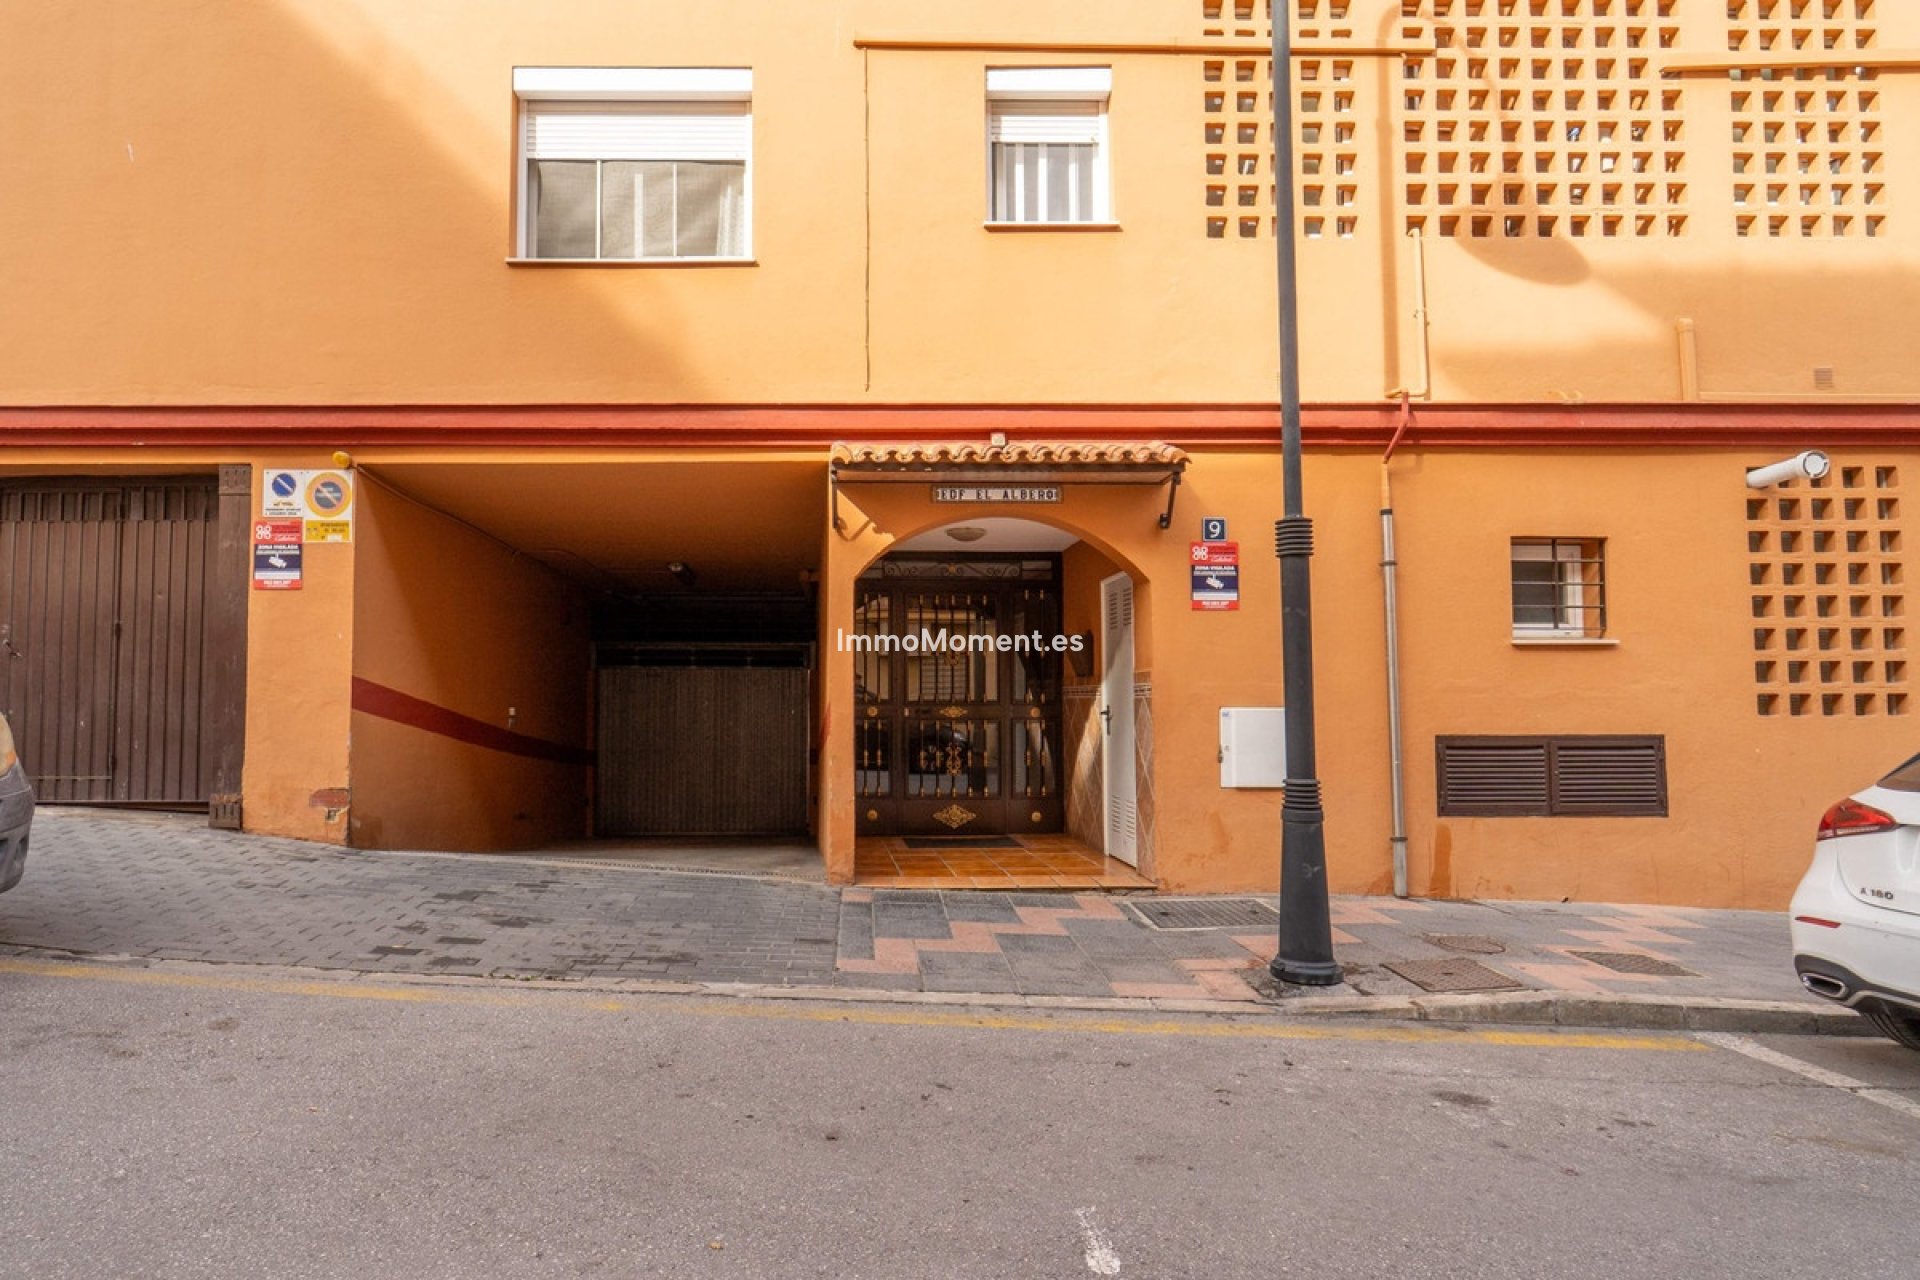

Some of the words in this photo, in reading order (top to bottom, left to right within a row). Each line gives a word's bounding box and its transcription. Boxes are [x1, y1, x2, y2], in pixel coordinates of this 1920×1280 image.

[942, 489, 966, 500] EDF
[976, 489, 992, 500] EL
[1002, 489, 1054, 500] ALBERO
[1209, 521, 1221, 539] 9
[1871, 889, 1894, 900] 180
